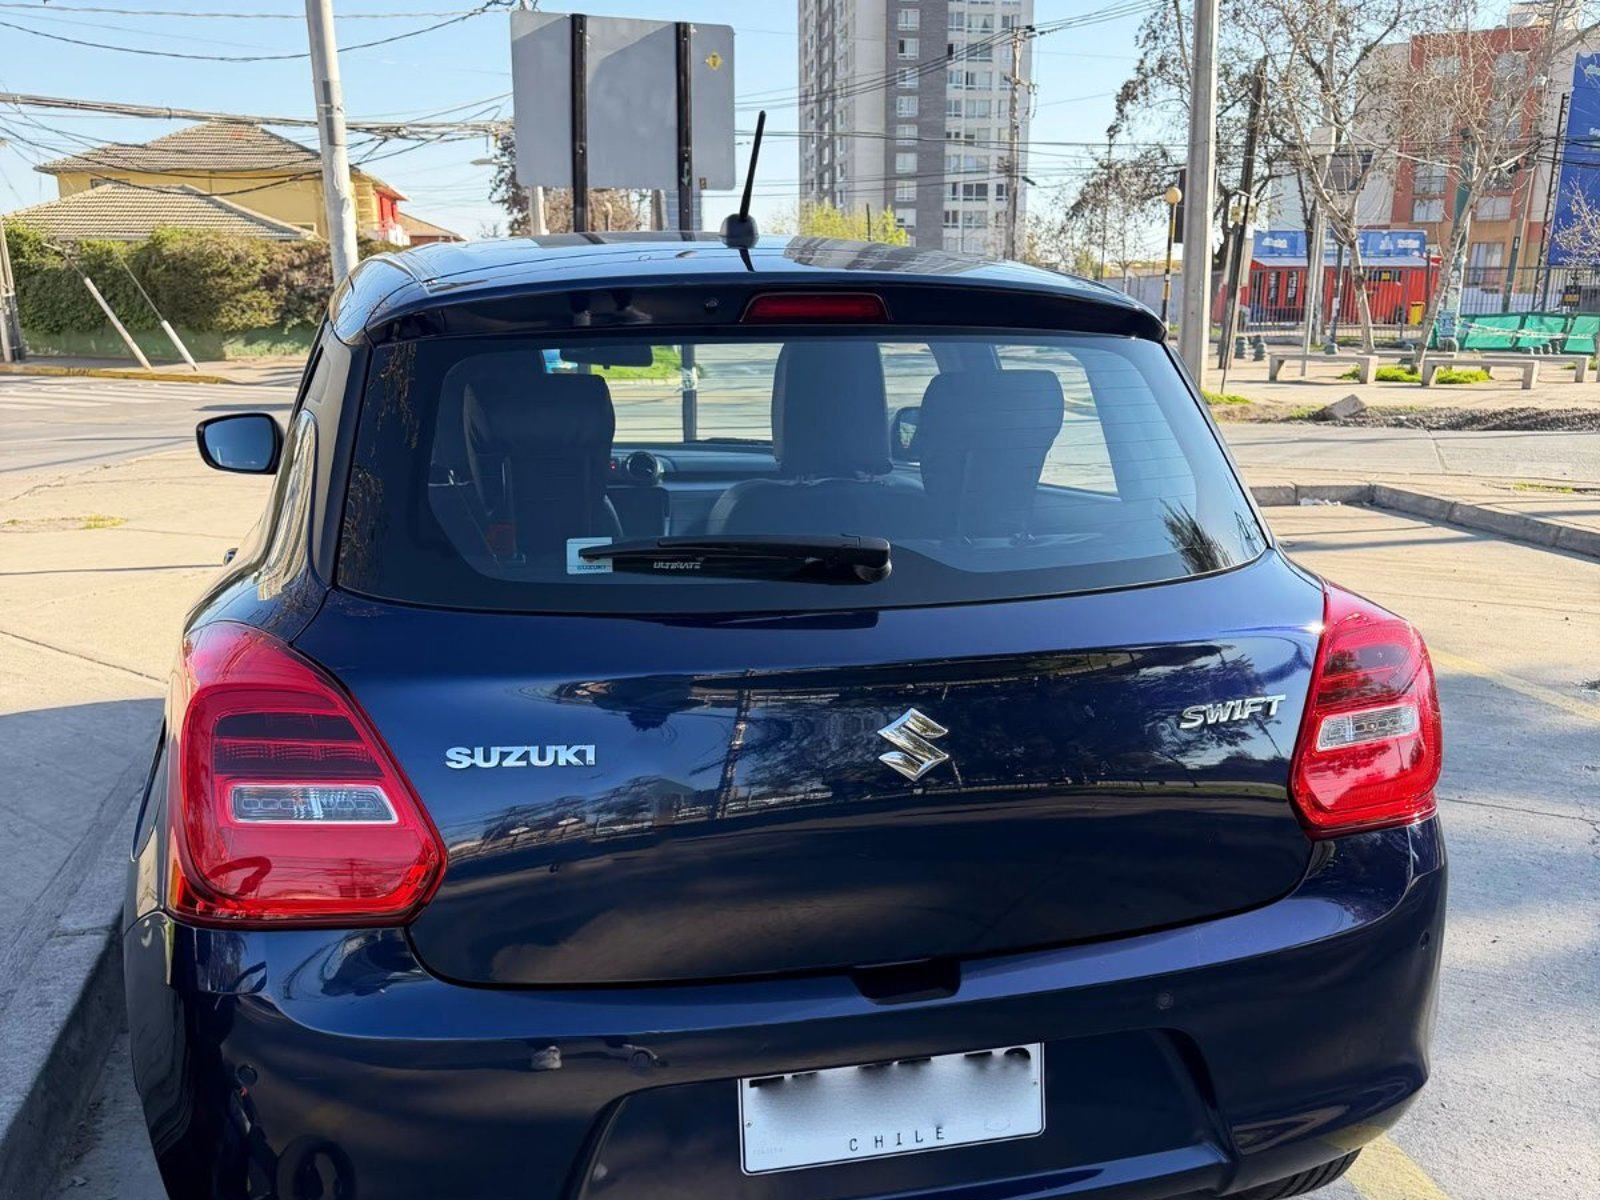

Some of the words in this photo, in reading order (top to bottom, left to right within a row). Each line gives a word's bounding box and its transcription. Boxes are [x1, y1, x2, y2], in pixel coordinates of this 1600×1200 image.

[653, 561, 702, 570] ULTIMATE
[1180, 694, 1287, 729] SWIFT
[445, 744, 596, 769] SUZUKI
[849, 1126, 945, 1152] CHILE
